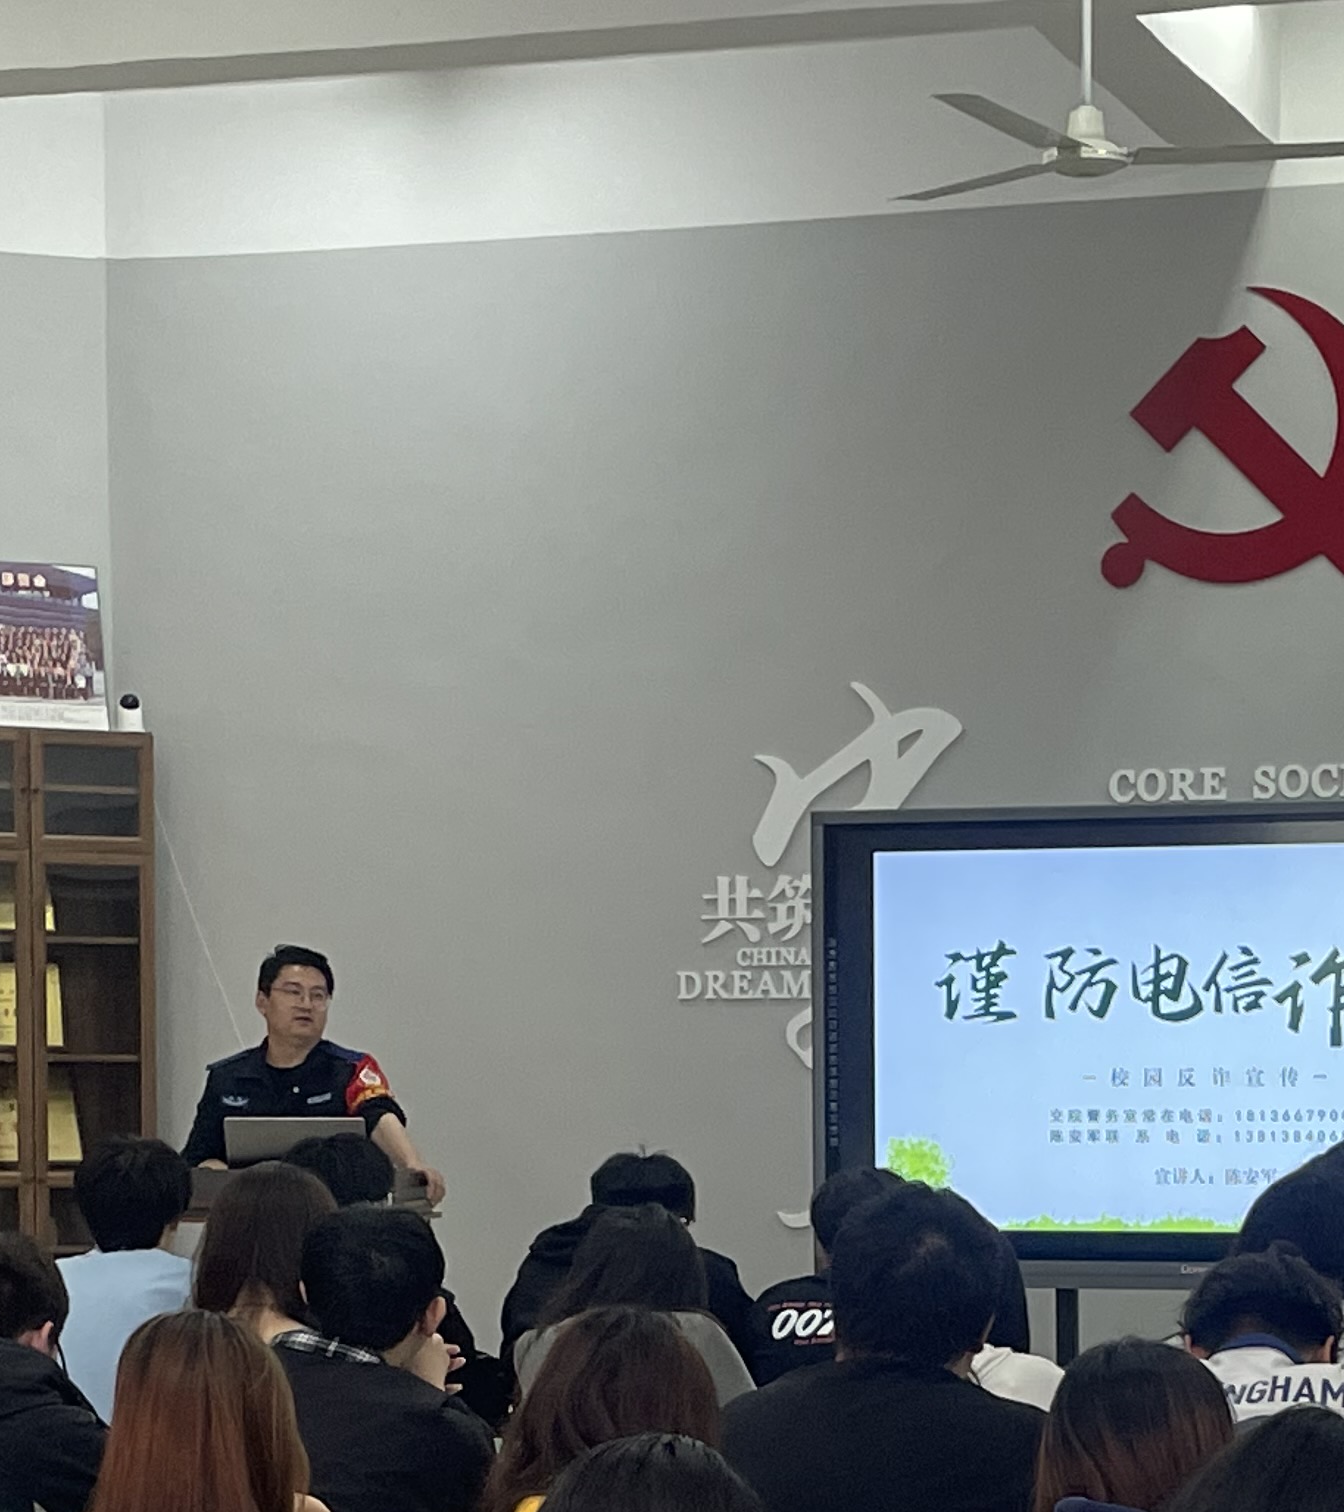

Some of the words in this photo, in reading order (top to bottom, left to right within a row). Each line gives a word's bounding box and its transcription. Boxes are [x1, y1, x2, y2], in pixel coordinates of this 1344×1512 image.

[1109, 767, 1227, 803] CORE
[736, 947, 811, 967] CHINA
[677, 971, 811, 1001] DREAM
